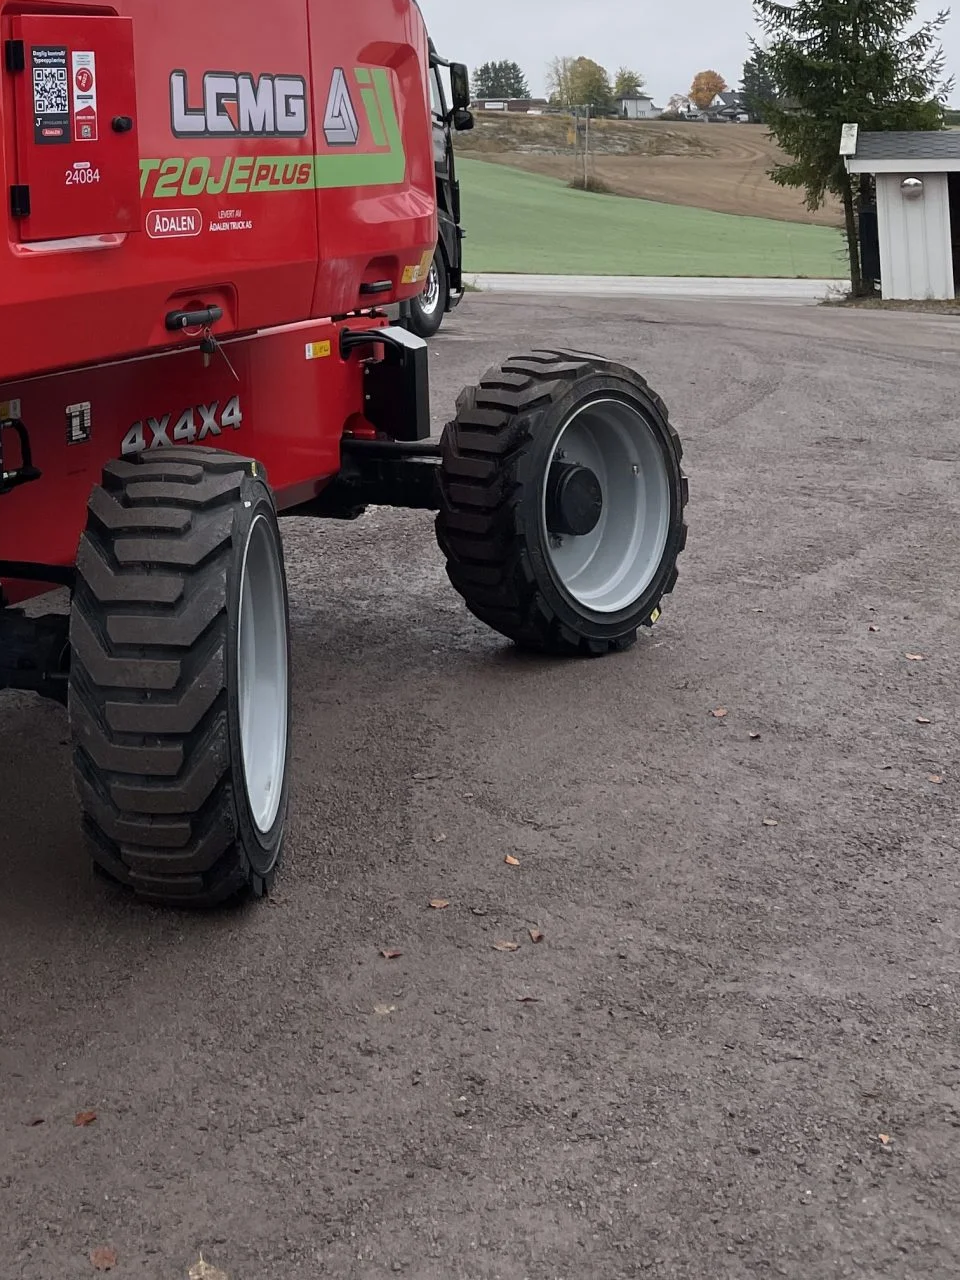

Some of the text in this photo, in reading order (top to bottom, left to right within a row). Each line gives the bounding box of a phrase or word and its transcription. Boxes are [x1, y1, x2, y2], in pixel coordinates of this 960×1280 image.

[170, 69, 307, 139] LGMG
[65, 169, 100, 185] 24084
[154, 214, 195, 233] ÅDALEN
[209, 221, 253, 232] ÅDALEN TRUCK AS
[121, 395, 243, 455] 4X4X4
